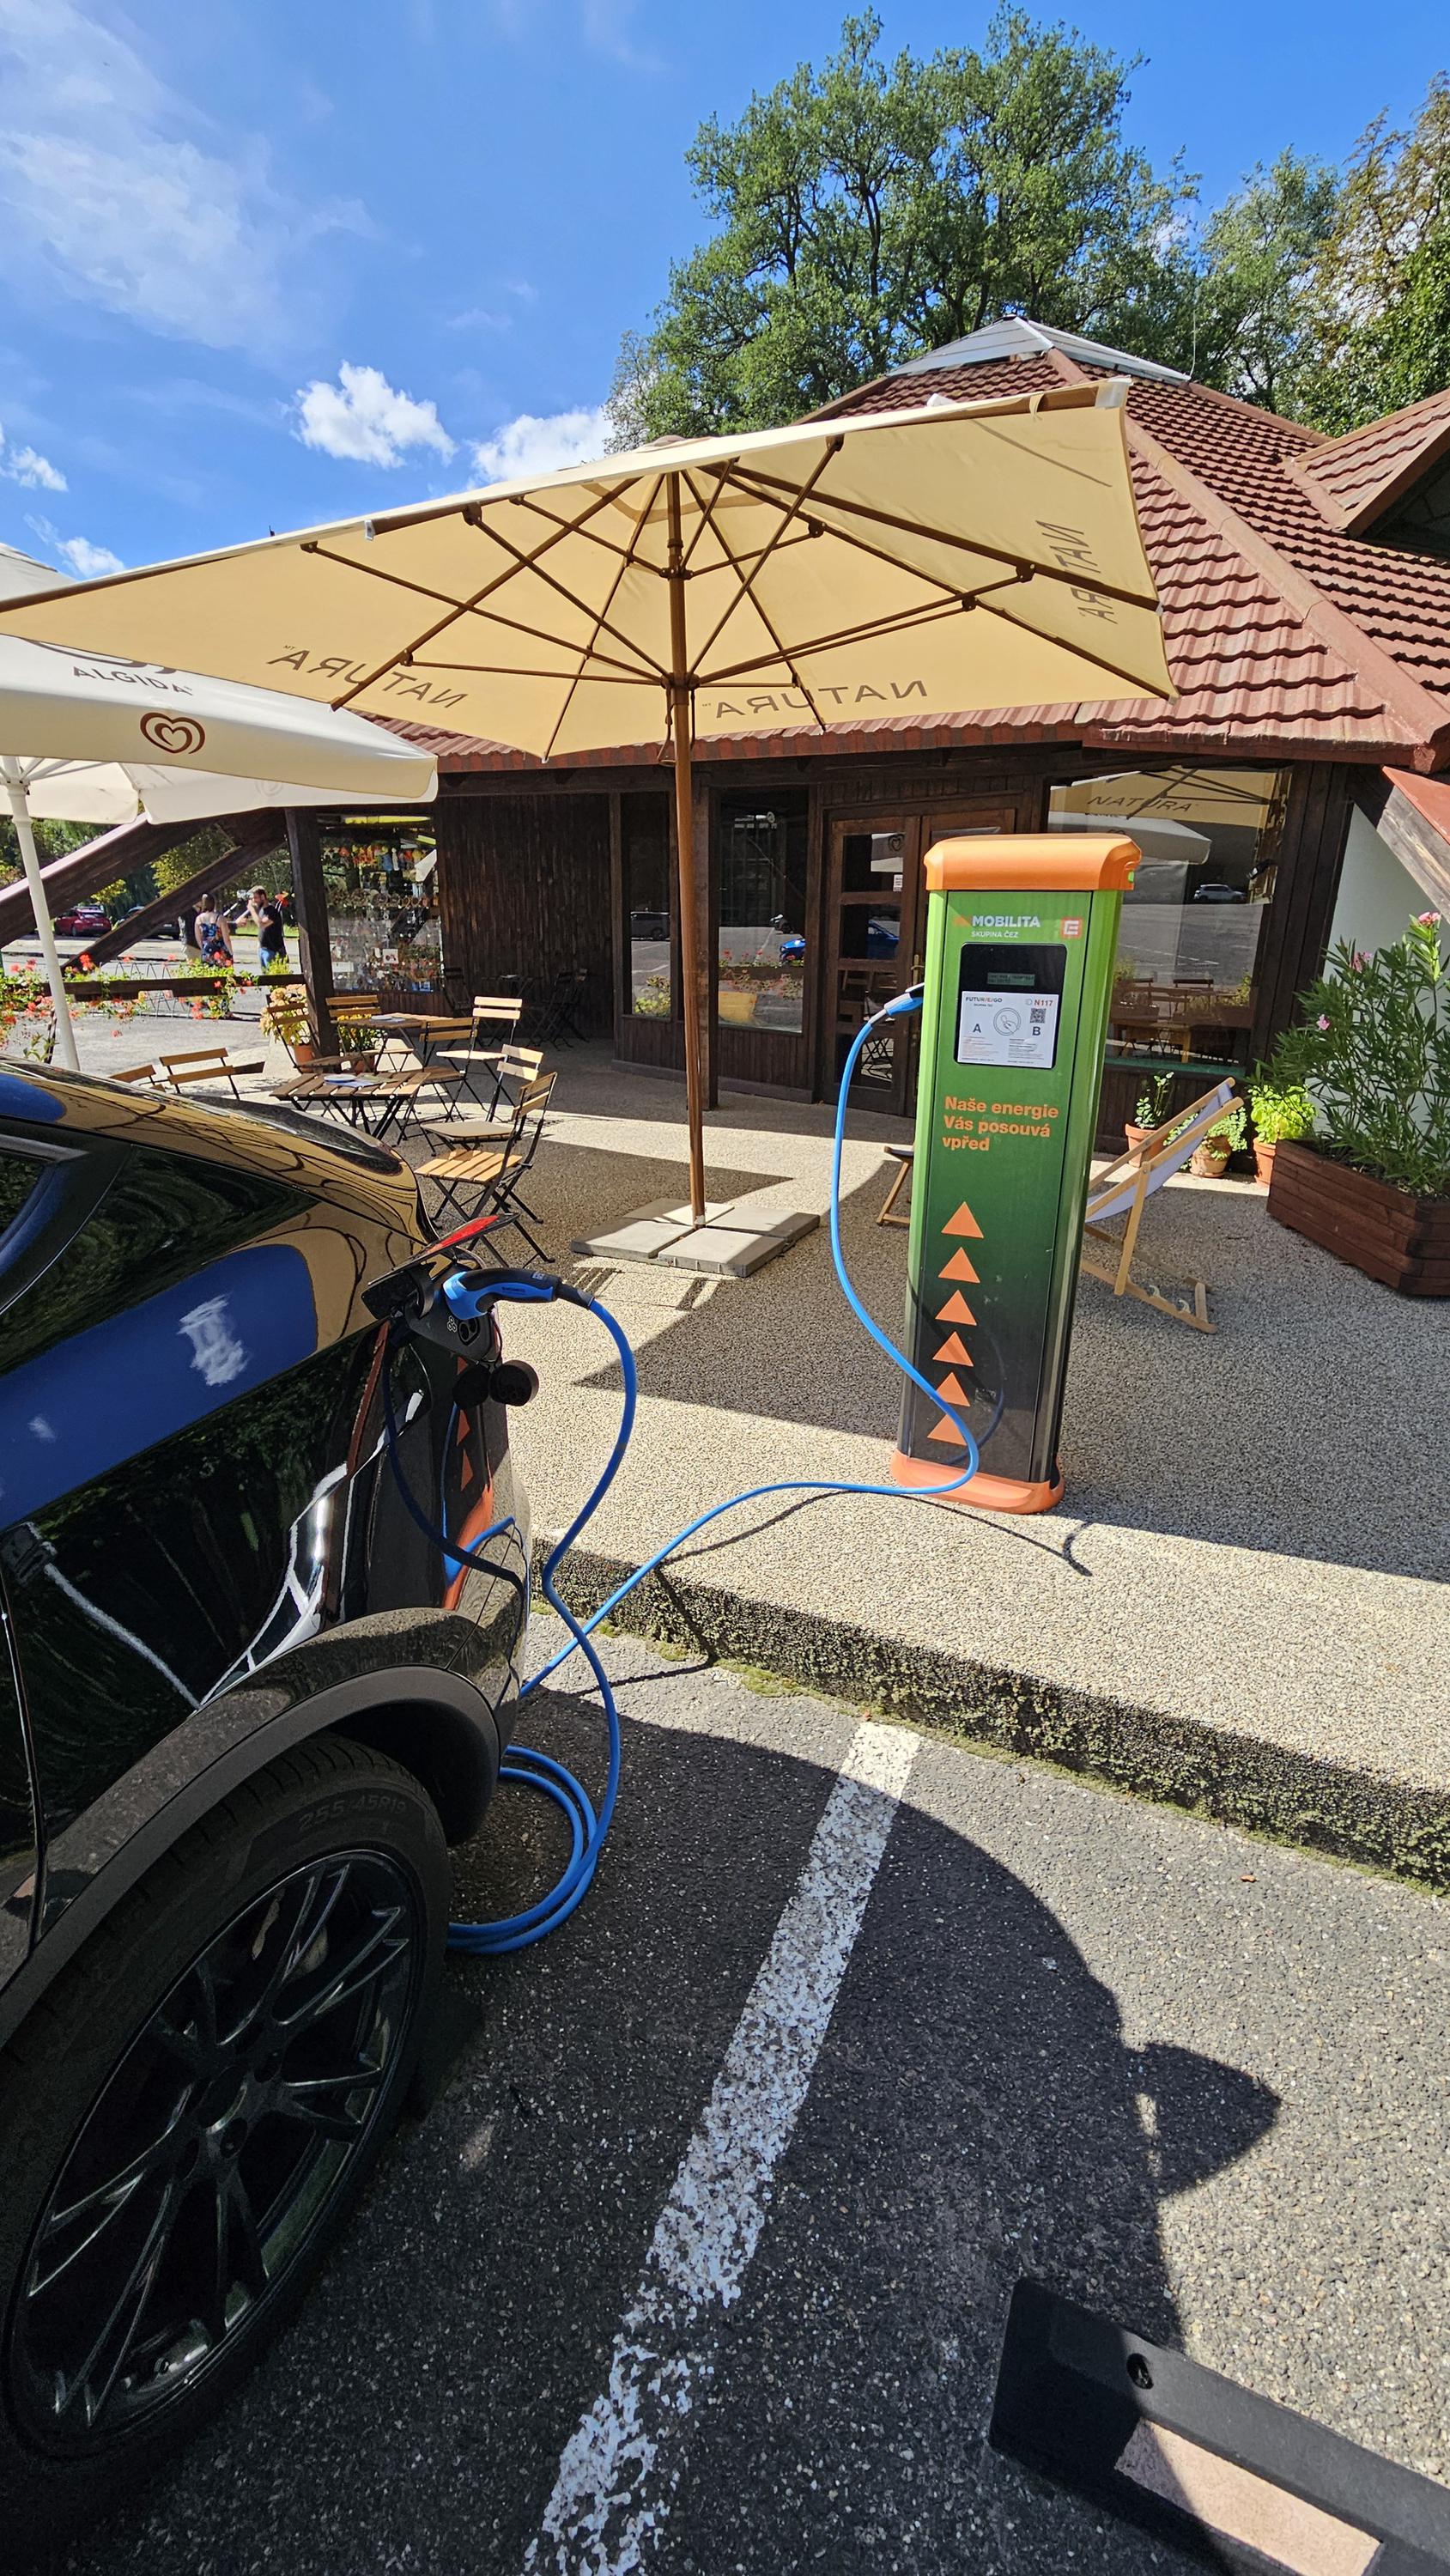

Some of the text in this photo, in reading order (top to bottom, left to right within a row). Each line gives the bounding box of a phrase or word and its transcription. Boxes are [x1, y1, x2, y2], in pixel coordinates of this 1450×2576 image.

[73, 666, 193, 696] ALGIDA
[972, 915, 1040, 927] MOBILITA
[1004, 929, 1019, 939] ČEZ
[973, 1024, 981, 1033] A
[1032, 1026, 1041, 1036] B
[944, 1096, 1059, 1120] Naše energie
[943, 1115, 1051, 1138] Vás posouvá
[942, 1135, 990, 1151] vpřed
